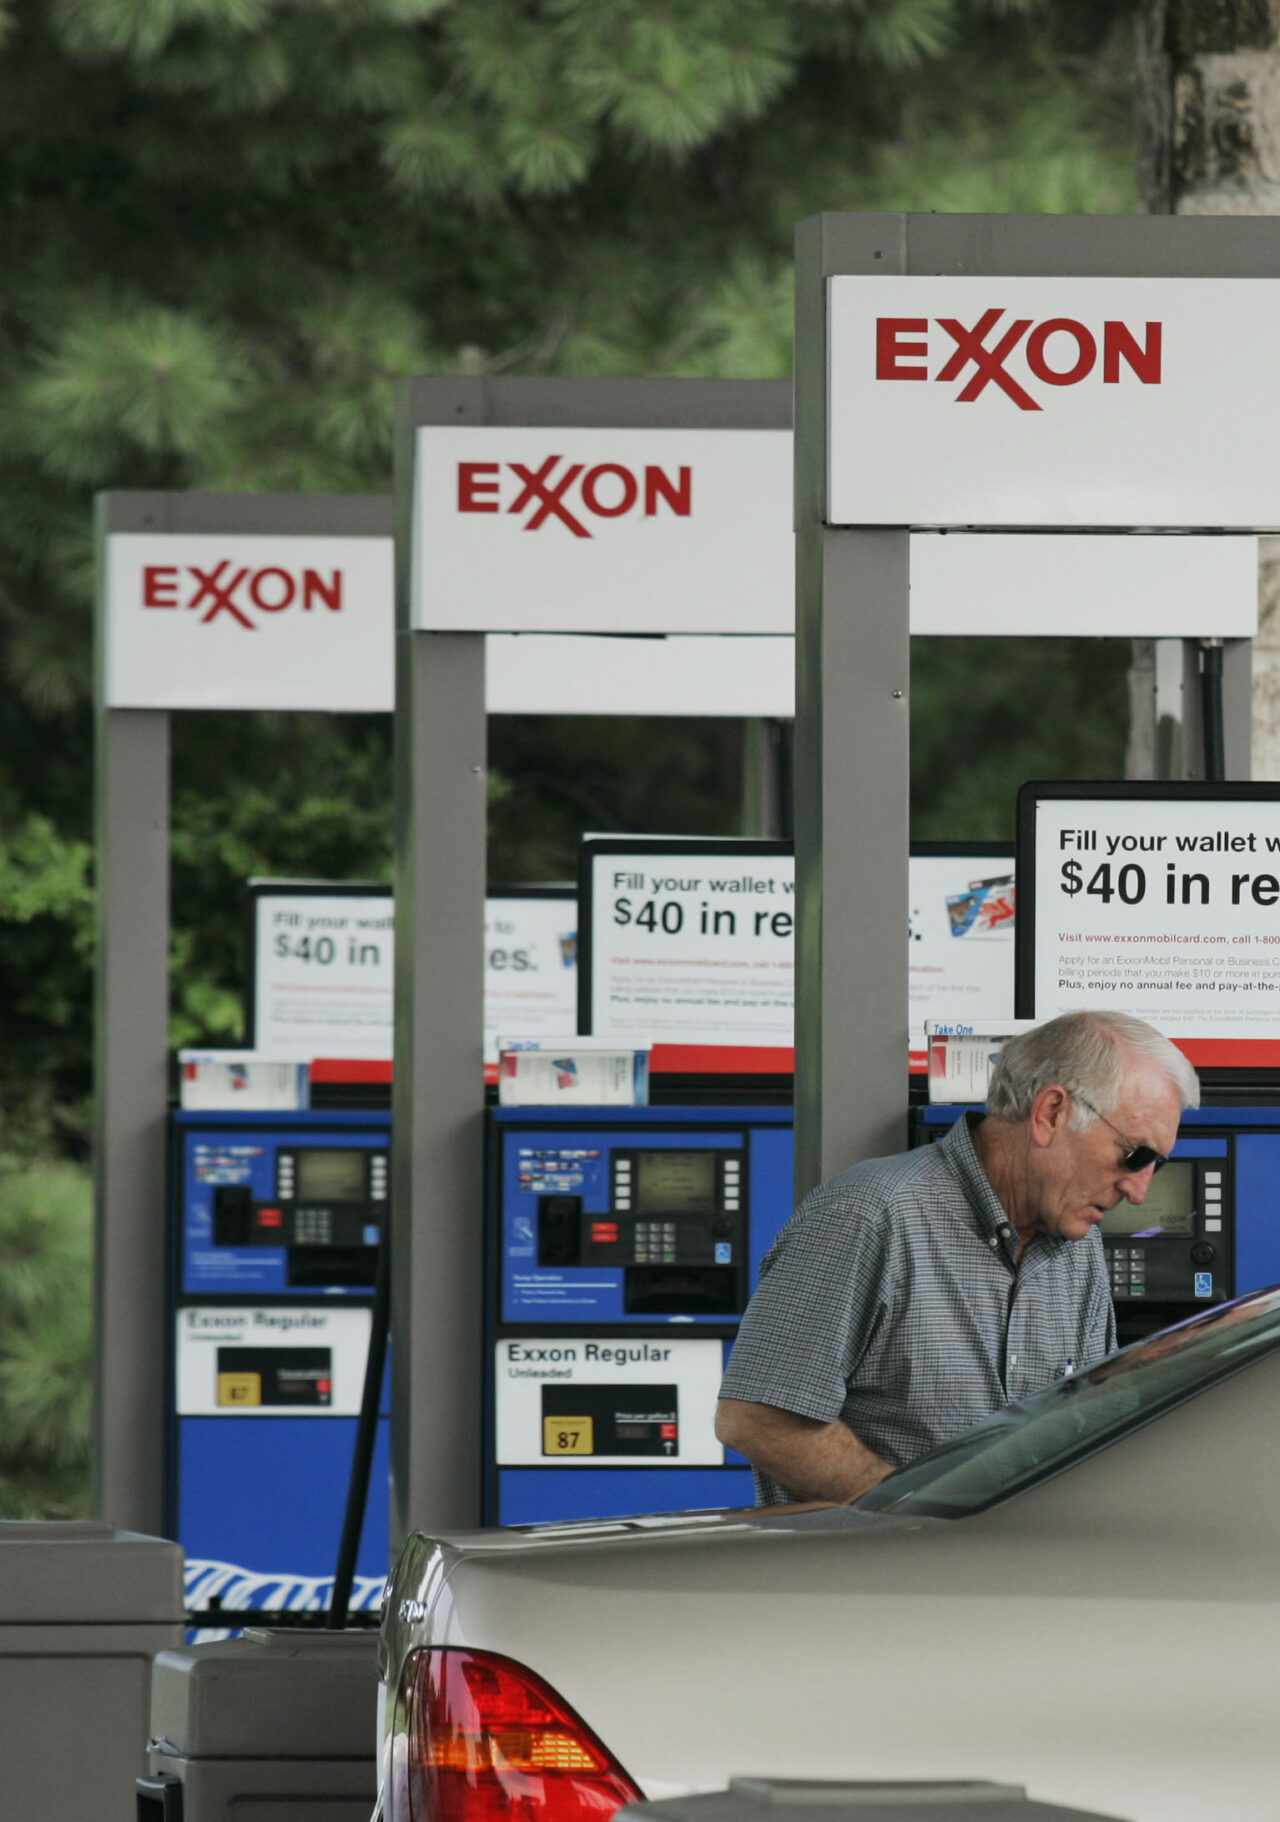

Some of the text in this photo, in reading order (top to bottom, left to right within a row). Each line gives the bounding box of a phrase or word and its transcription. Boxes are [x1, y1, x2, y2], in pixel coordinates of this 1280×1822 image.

[875, 308, 1162, 411] EXXON
[457, 454, 692, 538] EXXON
[142, 560, 343, 630] EXXON
[1059, 829, 1097, 851] Fill
[1106, 834, 1167, 856] your
[1175, 831, 1256, 853] wallet
[613, 872, 645, 890] Fill
[652, 877, 702, 894] your
[709, 877, 776, 894] wallet
[1060, 858, 1146, 905] $40
[1166, 863, 1211, 905] in
[356, 914, 393, 930] wall
[614, 896, 684, 935] $40
[700, 901, 737, 936] in
[274, 933, 380, 966] $40 in
[1058, 932, 1082, 943] Visit
[1085, 933, 1230, 945] www.exxonmobilcard.com,
[1232, 934, 1251, 944] call
[1058, 979, 1085, 990] Plus,
[1088, 981, 1117, 991] enjoy
[1120, 982, 1134, 990] no
[1136, 981, 1173, 990] annual
[1175, 981, 1192, 990] fee
[1195, 982, 1216, 990] and
[934, 1024, 974, 1035] Take One
[508, 1344, 672, 1365] Exxon Regular
[508, 1368, 573, 1379] Unleaded
[557, 1432, 580, 1449] 87
